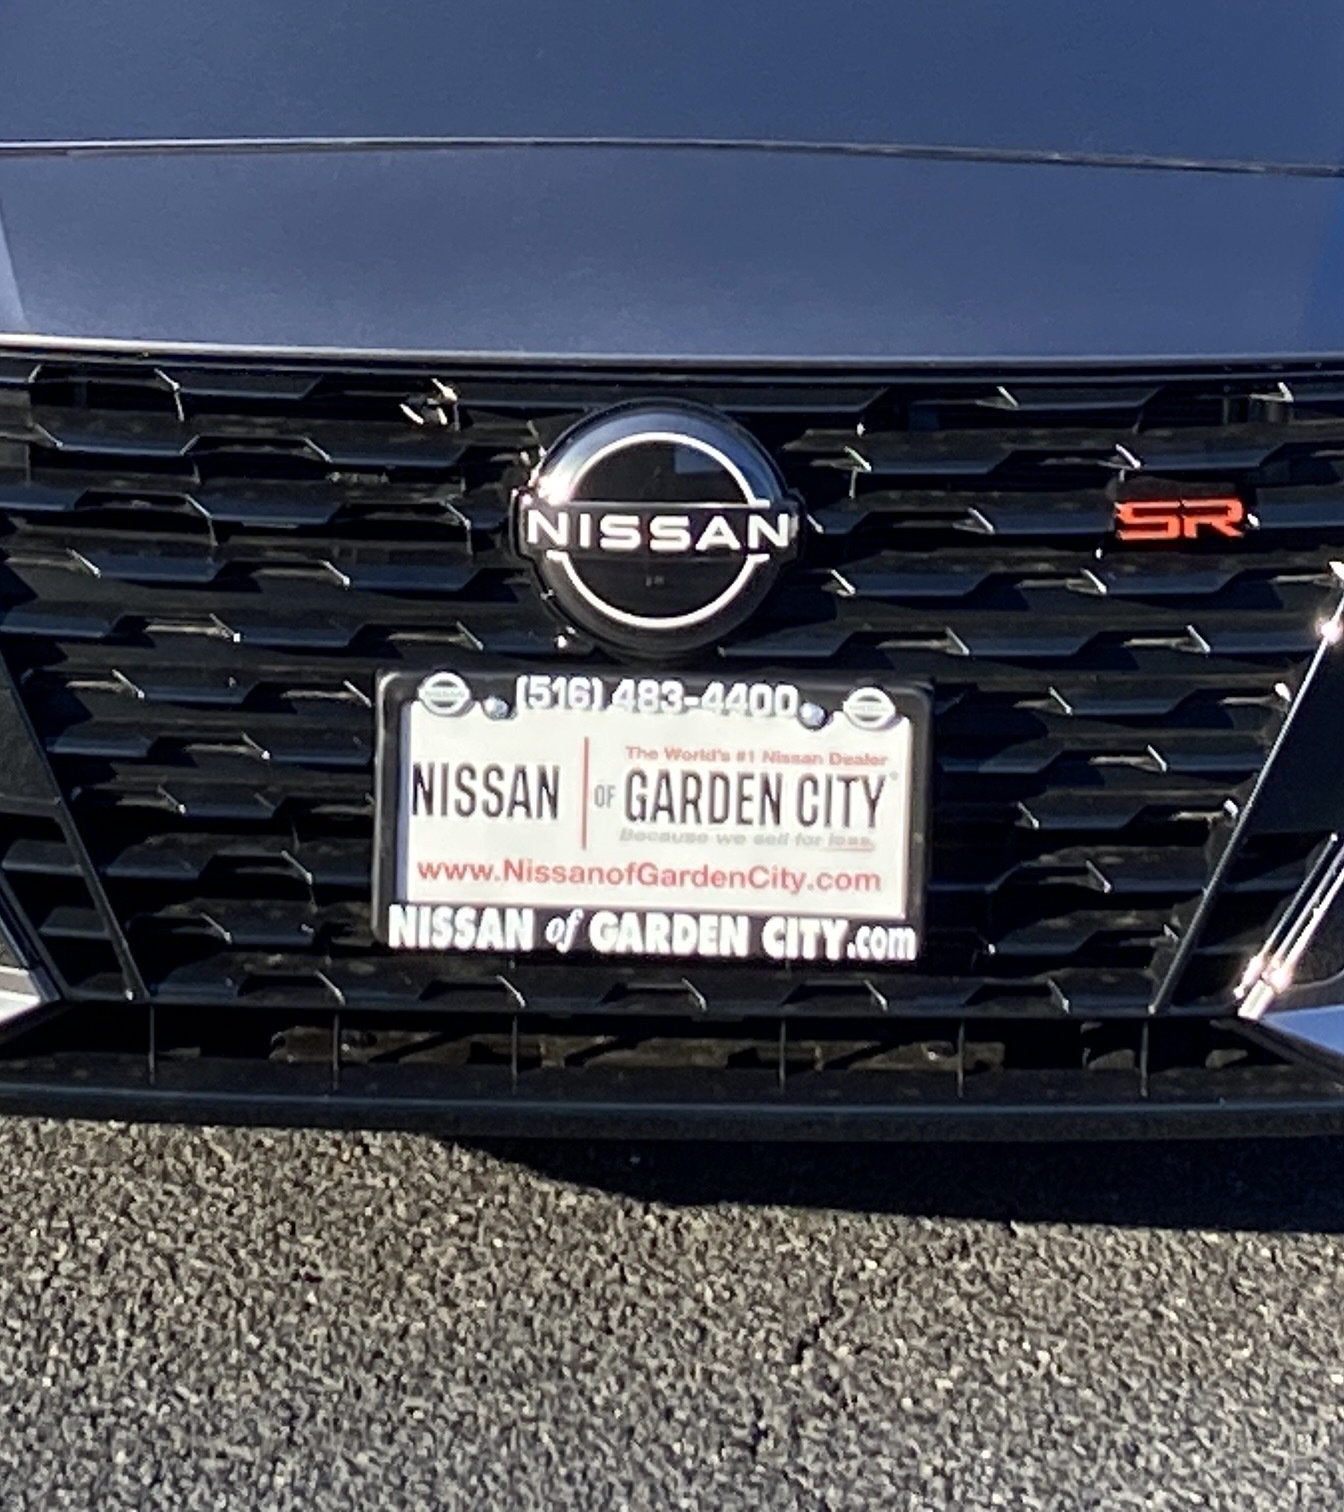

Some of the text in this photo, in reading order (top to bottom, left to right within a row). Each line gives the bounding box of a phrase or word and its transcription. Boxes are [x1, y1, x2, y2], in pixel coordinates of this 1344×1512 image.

[527, 509, 789, 552] NISSAN
[1114, 498, 1245, 541] SR
[516, 675, 800, 718] (516) 483-4400
[625, 746, 888, 767] The World's #1 Nissan Dealer
[412, 761, 886, 828] NISSAN OF GARDEN CITY
[620, 828, 708, 845] Because
[716, 833, 747, 845] we
[753, 831, 788, 846] sell
[795, 832, 822, 846] for
[417, 858, 882, 894] www.NissanofGardenCity.com
[388, 904, 916, 961] NISSAN of GARDEN CITY.com
